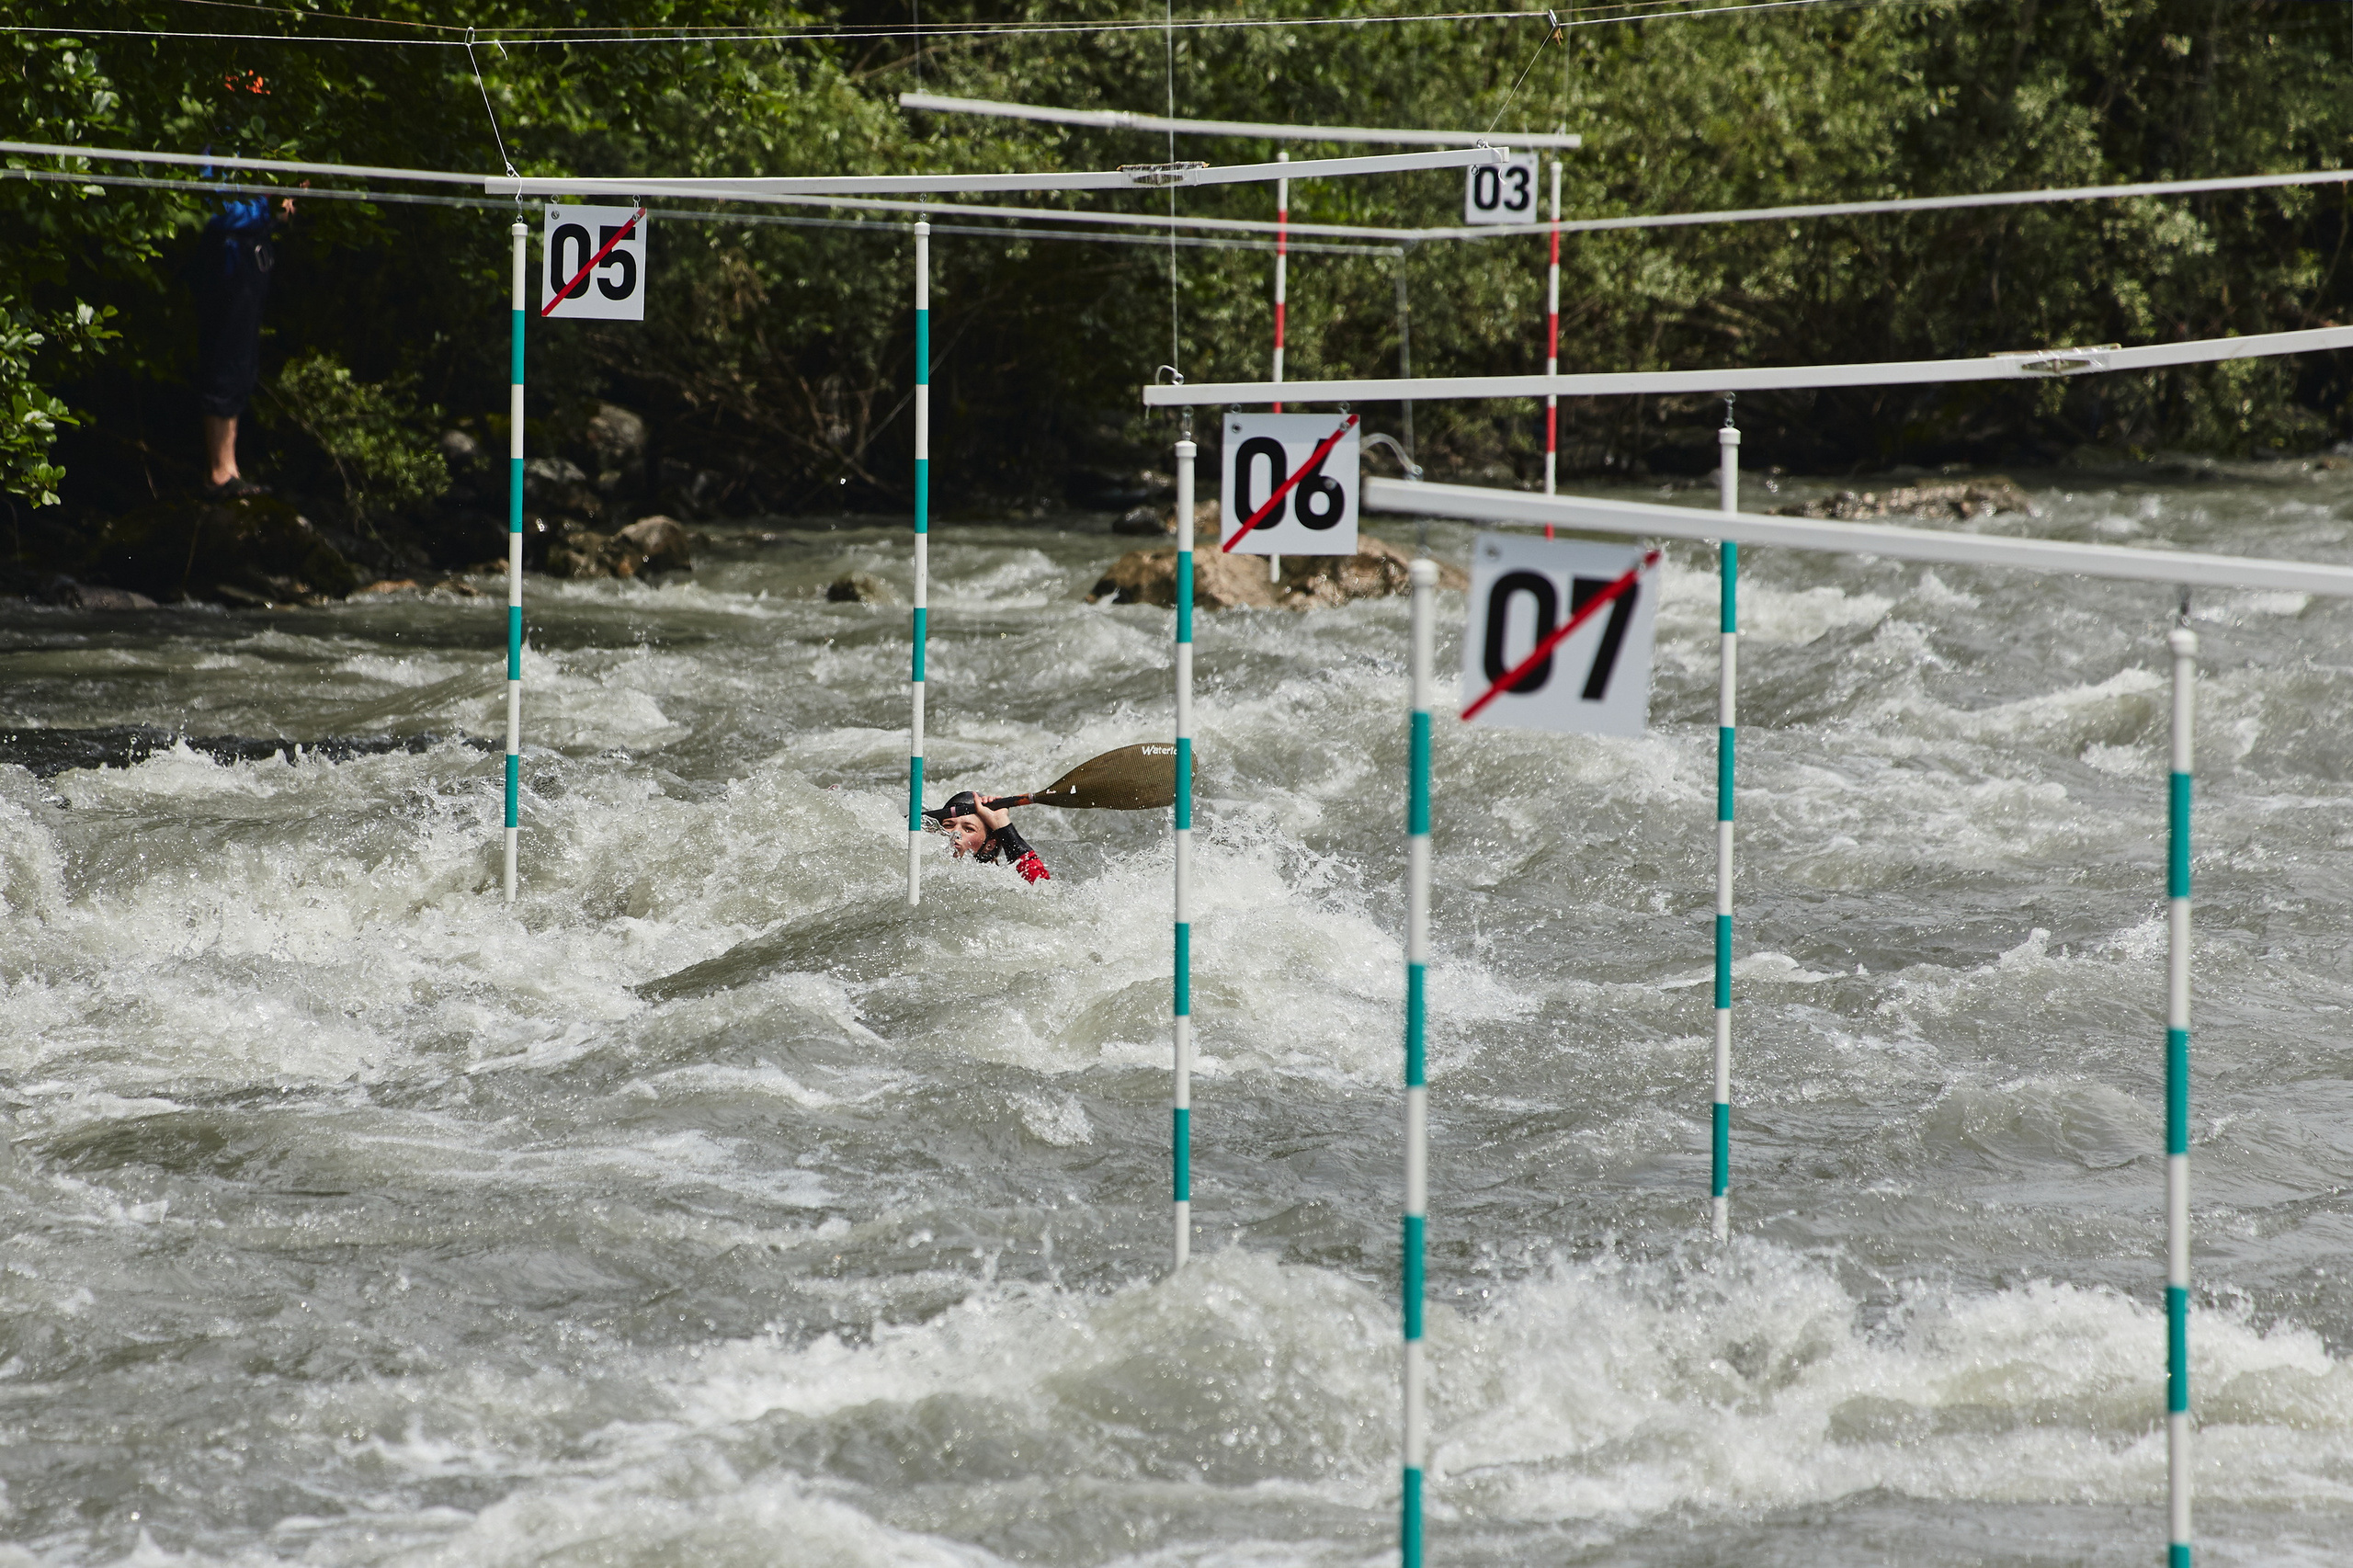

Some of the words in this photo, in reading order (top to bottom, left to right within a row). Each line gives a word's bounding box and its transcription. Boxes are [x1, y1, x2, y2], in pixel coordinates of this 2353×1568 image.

[1474, 165, 1530, 211] 03
[551, 223, 637, 301] 05
[1234, 437, 1346, 531] 06
[1483, 567, 1642, 704] 07
